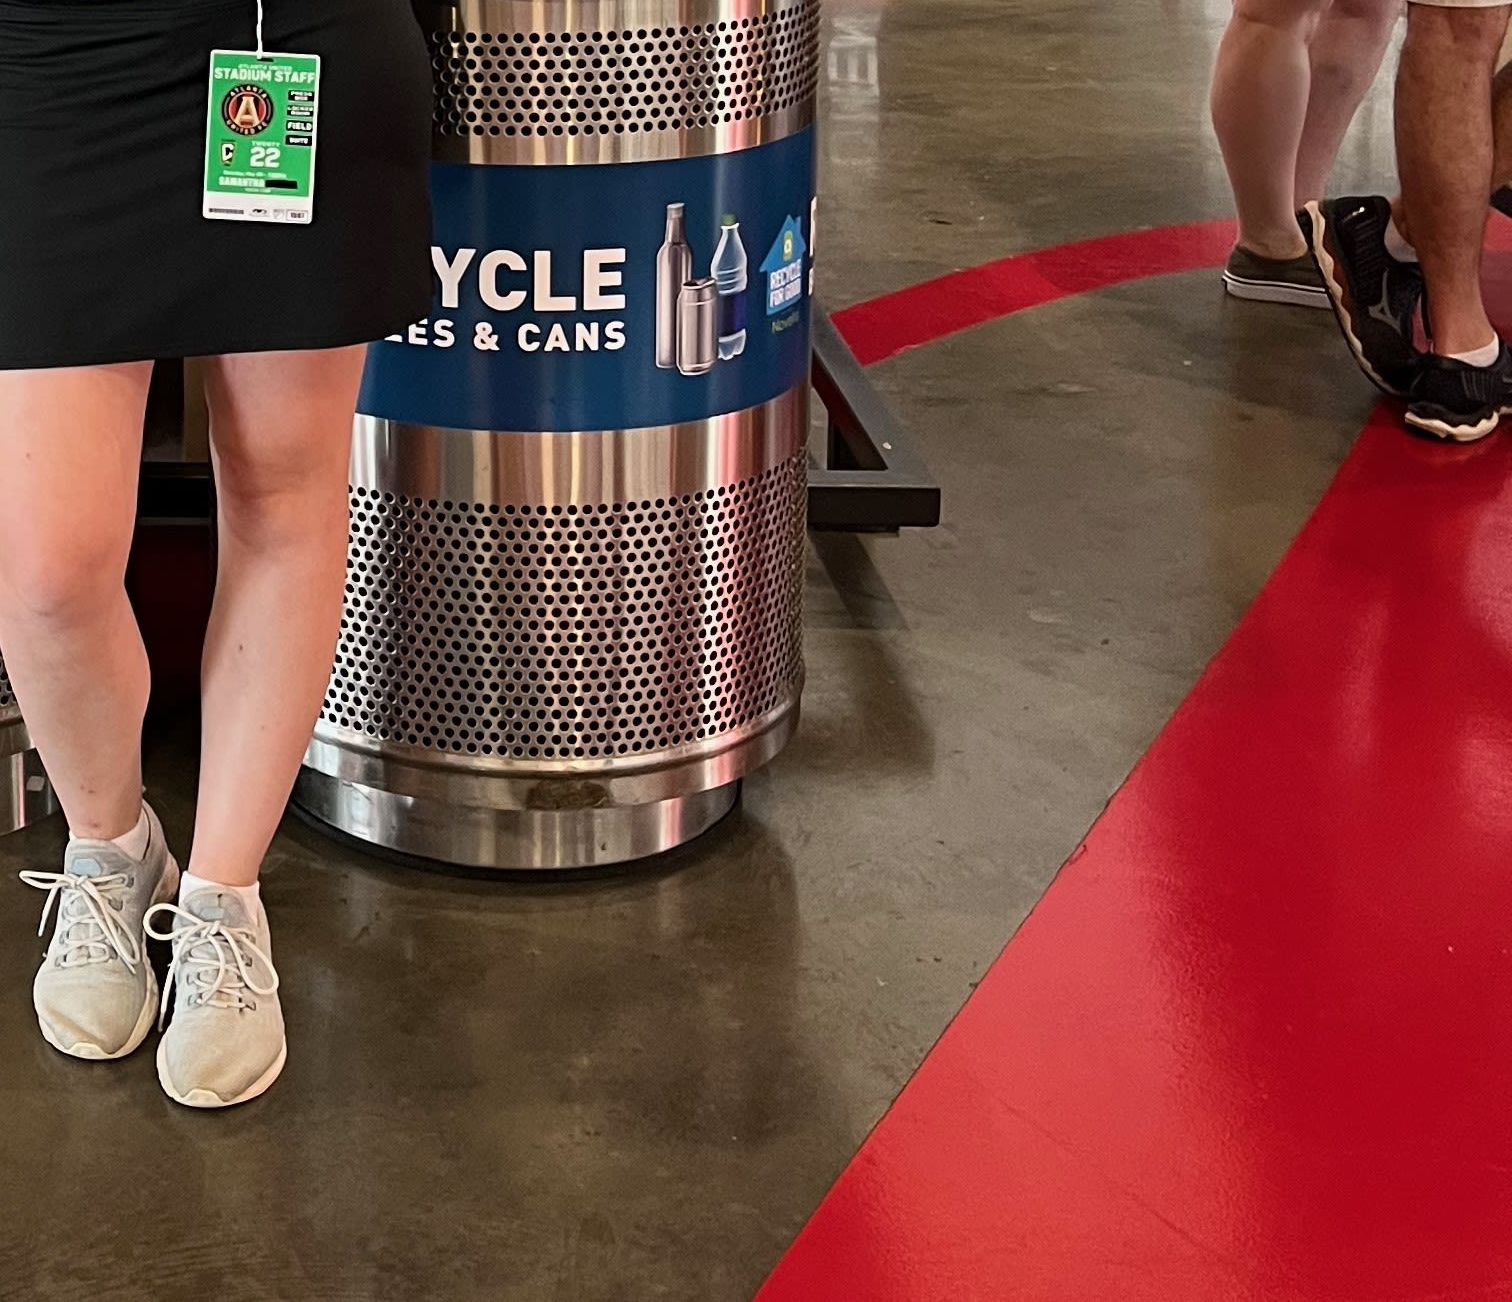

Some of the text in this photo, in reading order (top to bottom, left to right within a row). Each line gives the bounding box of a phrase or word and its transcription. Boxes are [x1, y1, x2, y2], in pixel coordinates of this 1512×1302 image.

[214, 67, 316, 84] STADIUM STAFF
[287, 122, 313, 131] FIELD
[250, 146, 281, 168] 22
[430, 245, 627, 312] YCLE
[385, 318, 627, 352] ES & CANS
